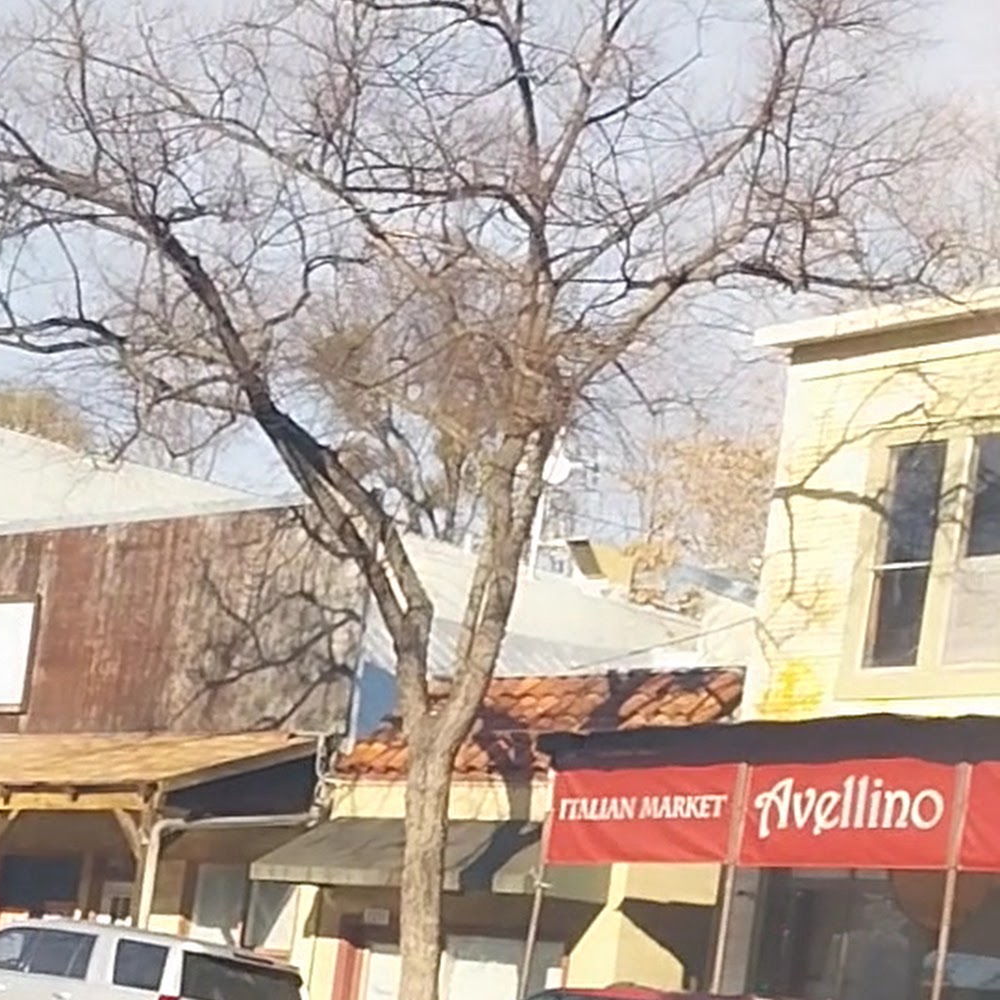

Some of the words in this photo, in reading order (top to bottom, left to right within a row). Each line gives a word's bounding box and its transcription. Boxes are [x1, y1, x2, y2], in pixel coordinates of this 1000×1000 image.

[559, 796, 639, 821] ITALIAN
[640, 793, 727, 820] MARKET
[755, 776, 944, 839] Avellino
